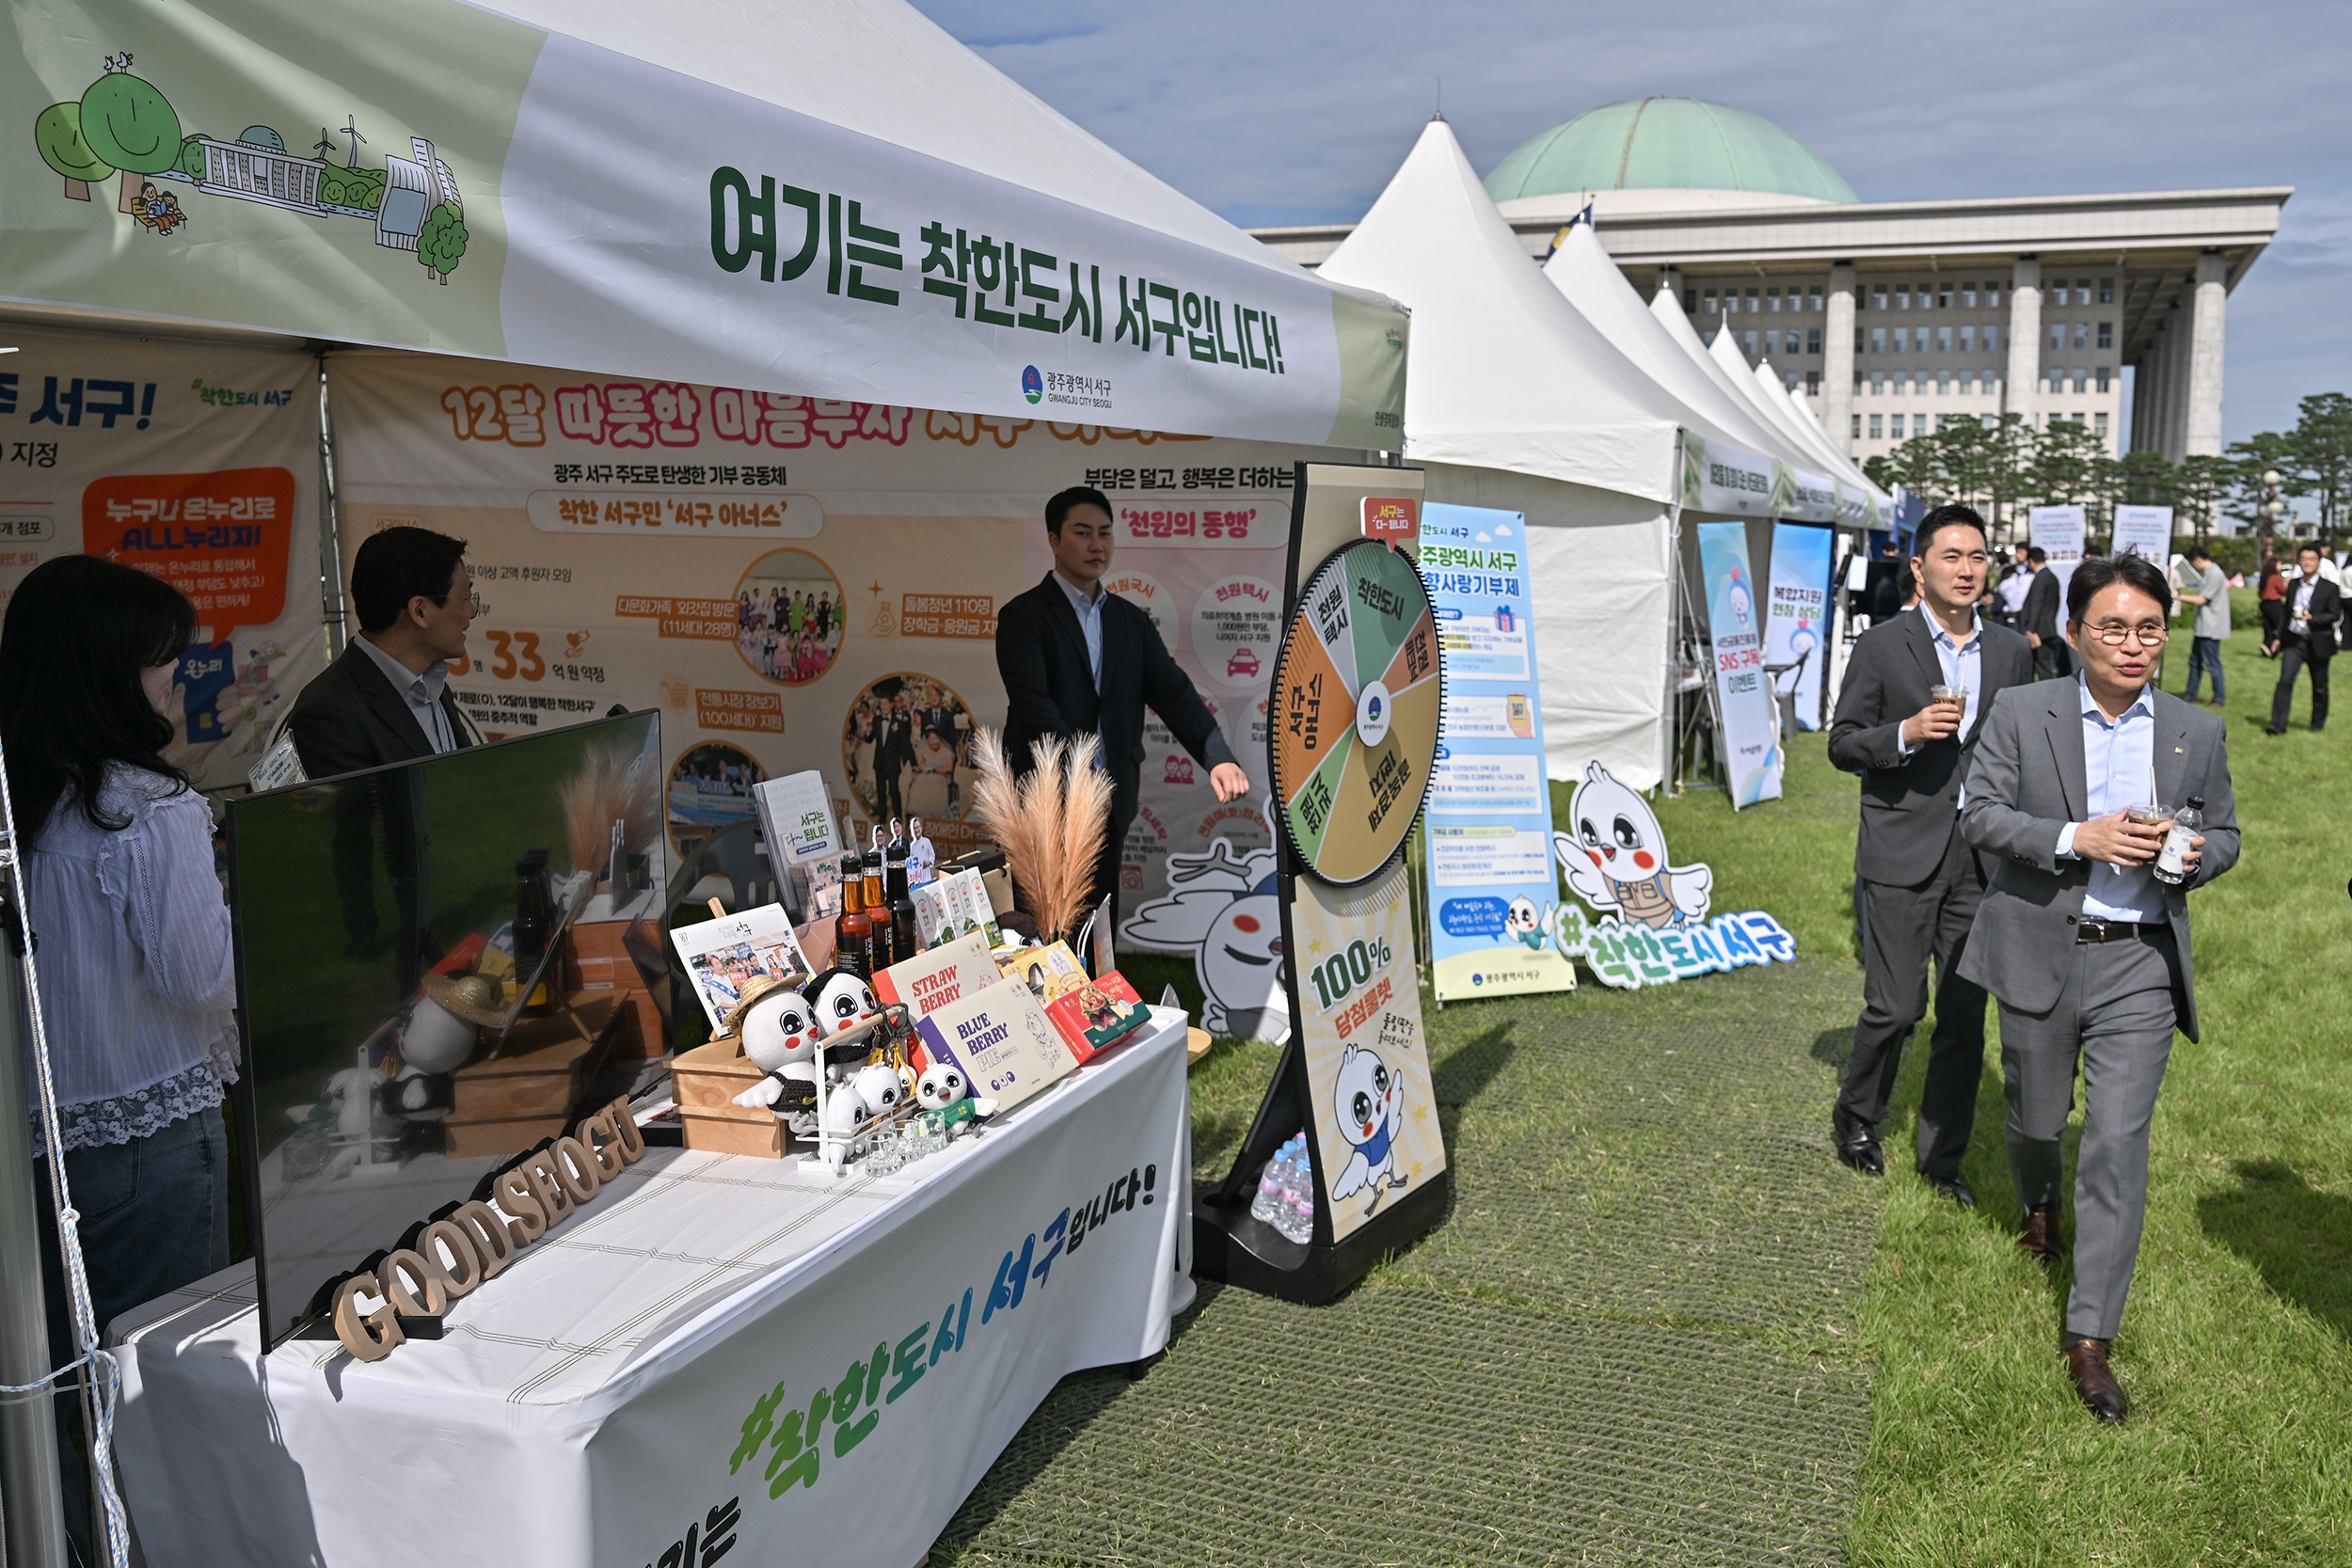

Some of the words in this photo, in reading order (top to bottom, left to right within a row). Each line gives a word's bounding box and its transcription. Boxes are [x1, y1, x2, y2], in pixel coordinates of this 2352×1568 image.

[710, 165, 903, 307] 여기는
[920, 220, 1103, 343] 착한도시
[1114, 275, 1285, 375] 서구입니다!
[191, 377, 258, 406] #착한도시
[1047, 372, 1092, 395] 광주광역시
[1094, 379, 1112, 397] 서구
[29, 376, 157, 430] 서구!
[1048, 392, 1078, 405] GWANGJU
[1079, 397, 1092, 406] CITY
[1093, 398, 1112, 408] SEOGU
[441, 384, 546, 447] 12달
[554, 383, 701, 449] 따뜻한
[554, 464, 583, 483] 광주
[585, 465, 613, 483] 서구
[616, 465, 659, 483] 주도로
[661, 465, 706, 485] 탄생한
[709, 466, 739, 485] 기부
[741, 466, 787, 486] 공동체
[1084, 467, 1136, 490] 부담은
[1138, 468, 1176, 491] 덜고,
[1182, 467, 1234, 490] 행복은
[1239, 467, 1295, 489] 더하는
[106, 497, 180, 522] 누구나
[183, 497, 276, 521] 온누리로
[559, 499, 598, 526] 착한
[604, 499, 660, 527] 서구민
[667, 499, 714, 528] '서구
[719, 500, 787, 529] 아너스'
[1379, 505, 1405, 518] 서구는
[17, 521, 41, 536] 점포
[1120, 508, 1196, 539] '천원의
[1201, 508, 1258, 539] 동행'
[1389, 519, 1409, 531] 됩니다
[1420, 523, 1447, 537] 한도시
[1450, 527, 1470, 539] 서구
[121, 524, 263, 551] ALL누리자!
[168, 560, 212, 575] 온누리로
[214, 558, 256, 573] 통합해서
[1487, 550, 1518, 572] 서구
[197, 577, 228, 592] 부담도
[230, 576, 264, 590] 낮추고!
[477, 565, 497, 580] 이상
[500, 566, 518, 580] 고액
[521, 567, 550, 581] 후원자
[552, 568, 572, 583] 모임
[1418, 572, 1521, 597] 향사랑기부제
[215, 594, 250, 609] 편하게!
[905, 595, 952, 613] 돌봄청년
[954, 598, 991, 615] 110명
[1215, 582, 1270, 604] 천원택시
[1318, 584, 1343, 625] 천원
[1358, 577, 1405, 622] 착한도시
[1773, 586, 1823, 605] 복합지원
[617, 598, 672, 615] 다문화가족
[663, 620, 703, 636] (11세대
[704, 622, 737, 638] 28명)
[1324, 608, 1348, 646] 택시
[485, 630, 546, 681] 33
[552, 664, 564, 679] 억
[566, 665, 580, 681] 원
[581, 666, 605, 683] 약정
[1415, 629, 1430, 674] 천원
[1718, 651, 1739, 673] SNS
[184, 659, 223, 679] 온누리
[1727, 673, 1757, 694] 이벤트
[529, 696, 557, 710] 행복한
[745, 695, 780, 710] 장보기
[1290, 685, 1305, 736] 서구
[1304, 673, 1323, 750] 아너스
[519, 713, 538, 725] 역할
[760, 714, 783, 730] 지원
[1369, 750, 1396, 799] 1번지
[1311, 771, 1332, 816] 국시
[1368, 758, 1411, 833] 골목경제
[801, 811, 826, 827] 서구는
[1300, 792, 1322, 835] 천원
[803, 824, 830, 843] 됩니다
[924, 821, 959, 839] 장애인
[736, 921, 753, 936] 서구
[1560, 911, 1725, 982] #착한도시
[1720, 916, 1788, 958] 서구
[911, 964, 958, 998] STRAW
[1311, 935, 1392, 1011] 100%
[919, 983, 961, 1016] BERRY
[1334, 976, 1394, 1040] 당첨룰렛
[956, 1012, 992, 1040] BLUE
[966, 1022, 1009, 1056] BERRY
[976, 1047, 1002, 1072] PIE
[331, 1199, 515, 1362] GOOD
[493, 1094, 645, 1248] SEOGU
[645, 1496, 741, 1568] 기는
[729, 1287, 973, 1500] #착한도시
[981, 1164, 1157, 1325] 서구입니다!
